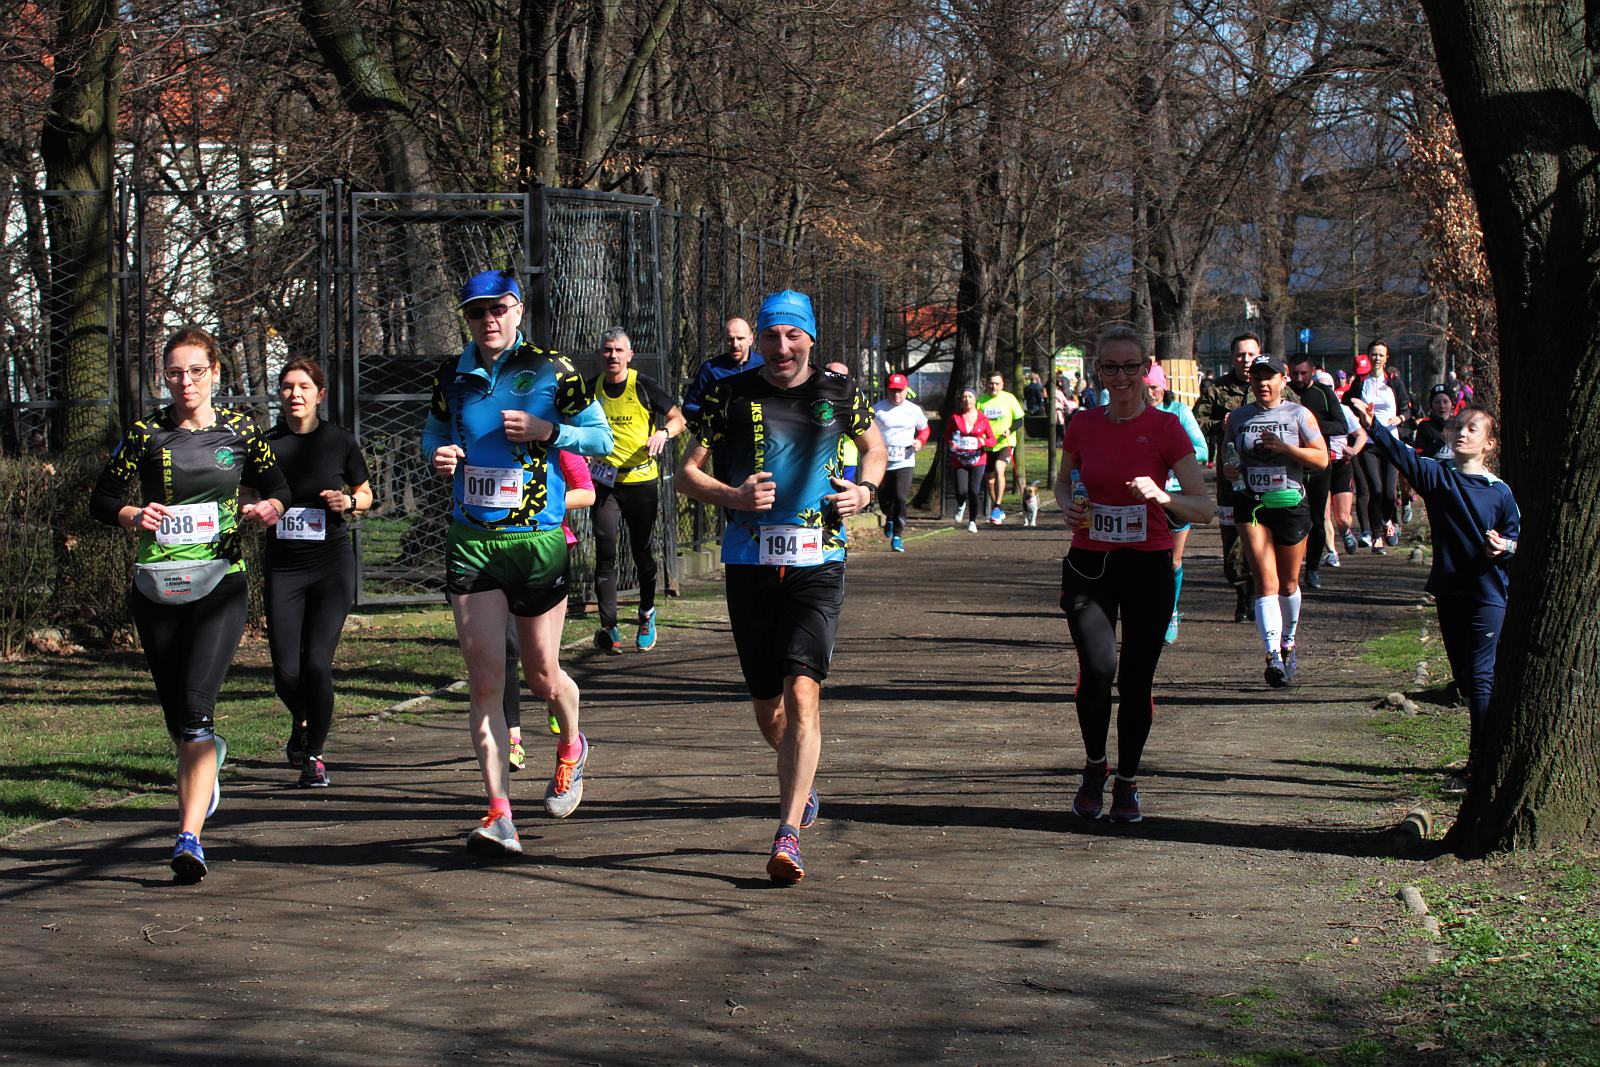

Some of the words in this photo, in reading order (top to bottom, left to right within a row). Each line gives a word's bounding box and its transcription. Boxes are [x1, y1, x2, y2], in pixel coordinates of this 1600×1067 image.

[751, 401, 763, 423] JKS
[1238, 423, 1289, 433] CROSSFIT
[162, 447, 172, 467] JKS
[468, 476, 496, 497] 010
[1249, 473, 1271, 486] 029
[160, 515, 194, 535] 038
[281, 516, 305, 531] 163
[1094, 513, 1122, 534] 091
[766, 535, 798, 555] 194
